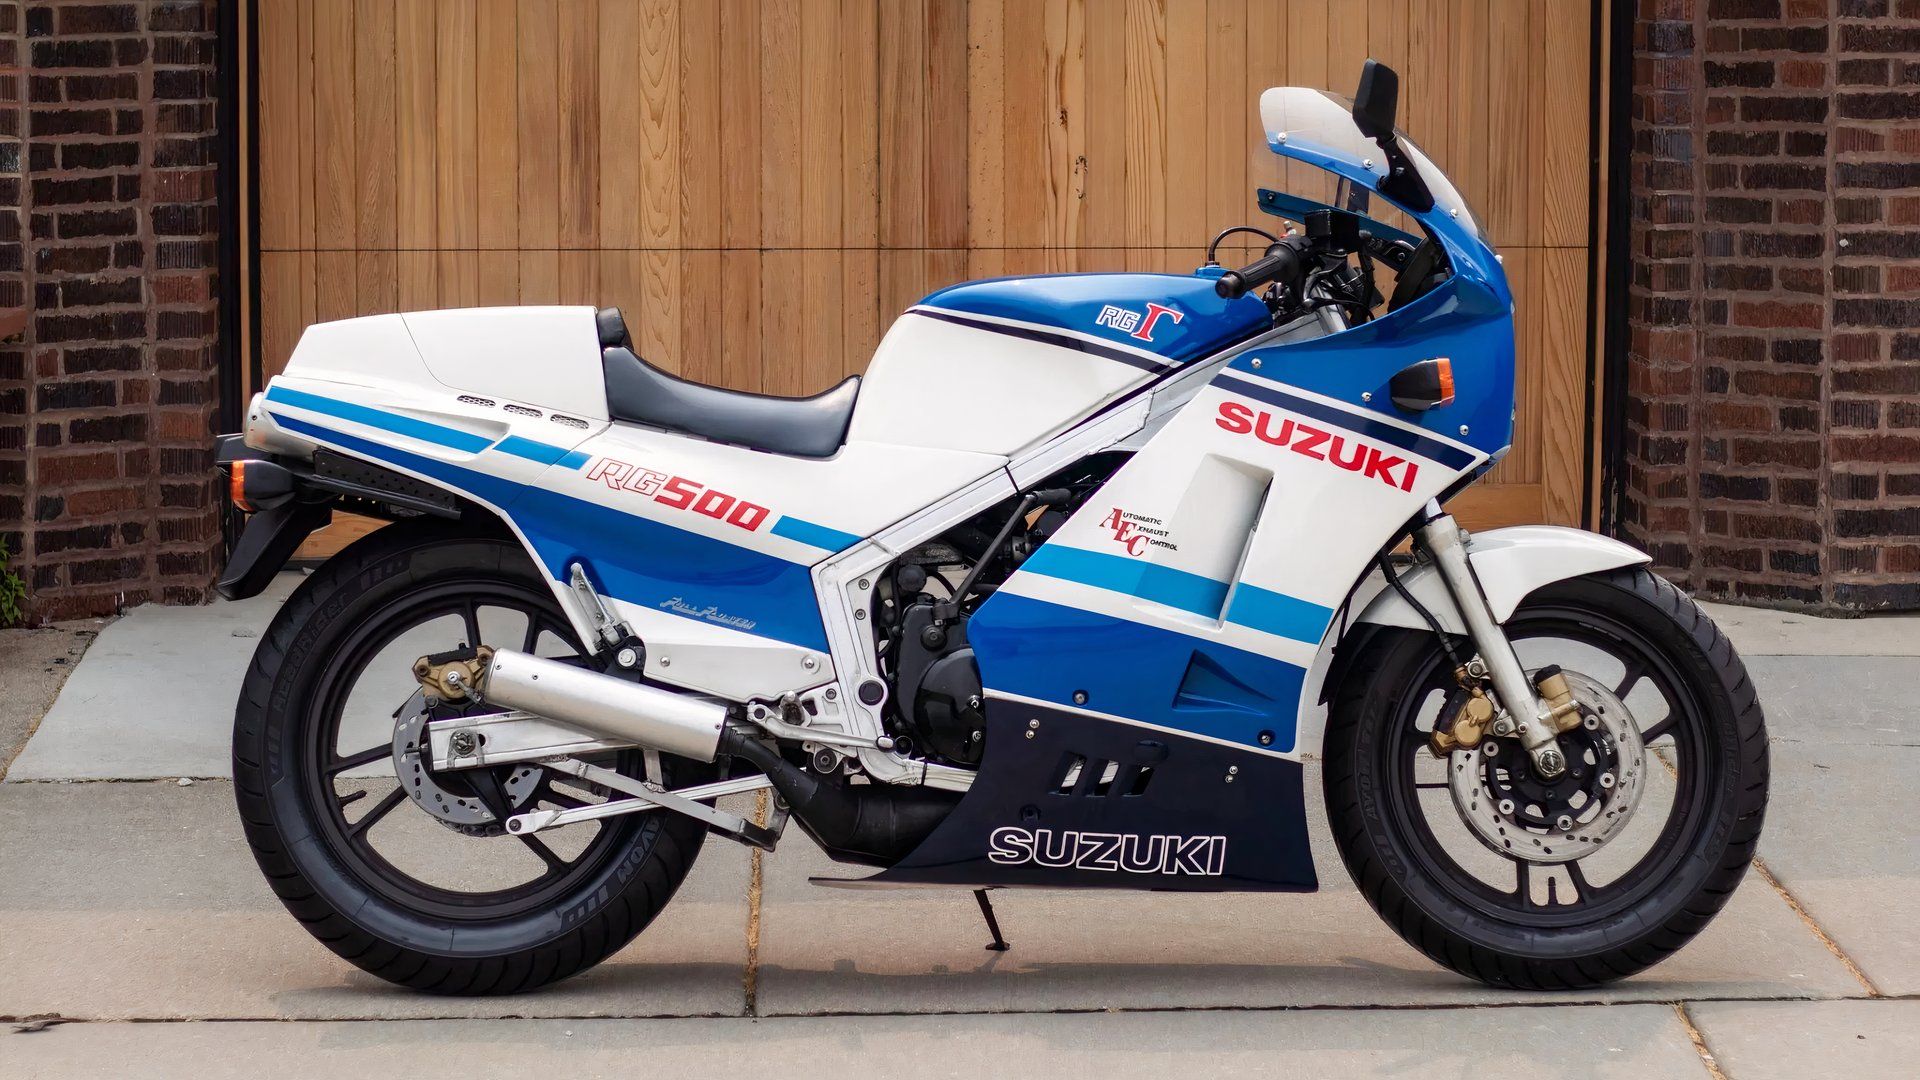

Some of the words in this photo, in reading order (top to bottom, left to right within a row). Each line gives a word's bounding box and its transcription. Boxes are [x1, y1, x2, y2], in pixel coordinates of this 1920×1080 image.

[1215, 401, 1419, 493] SUZUKI
[586, 457, 771, 532] RG500
[988, 827, 1227, 875] SUZUKI
